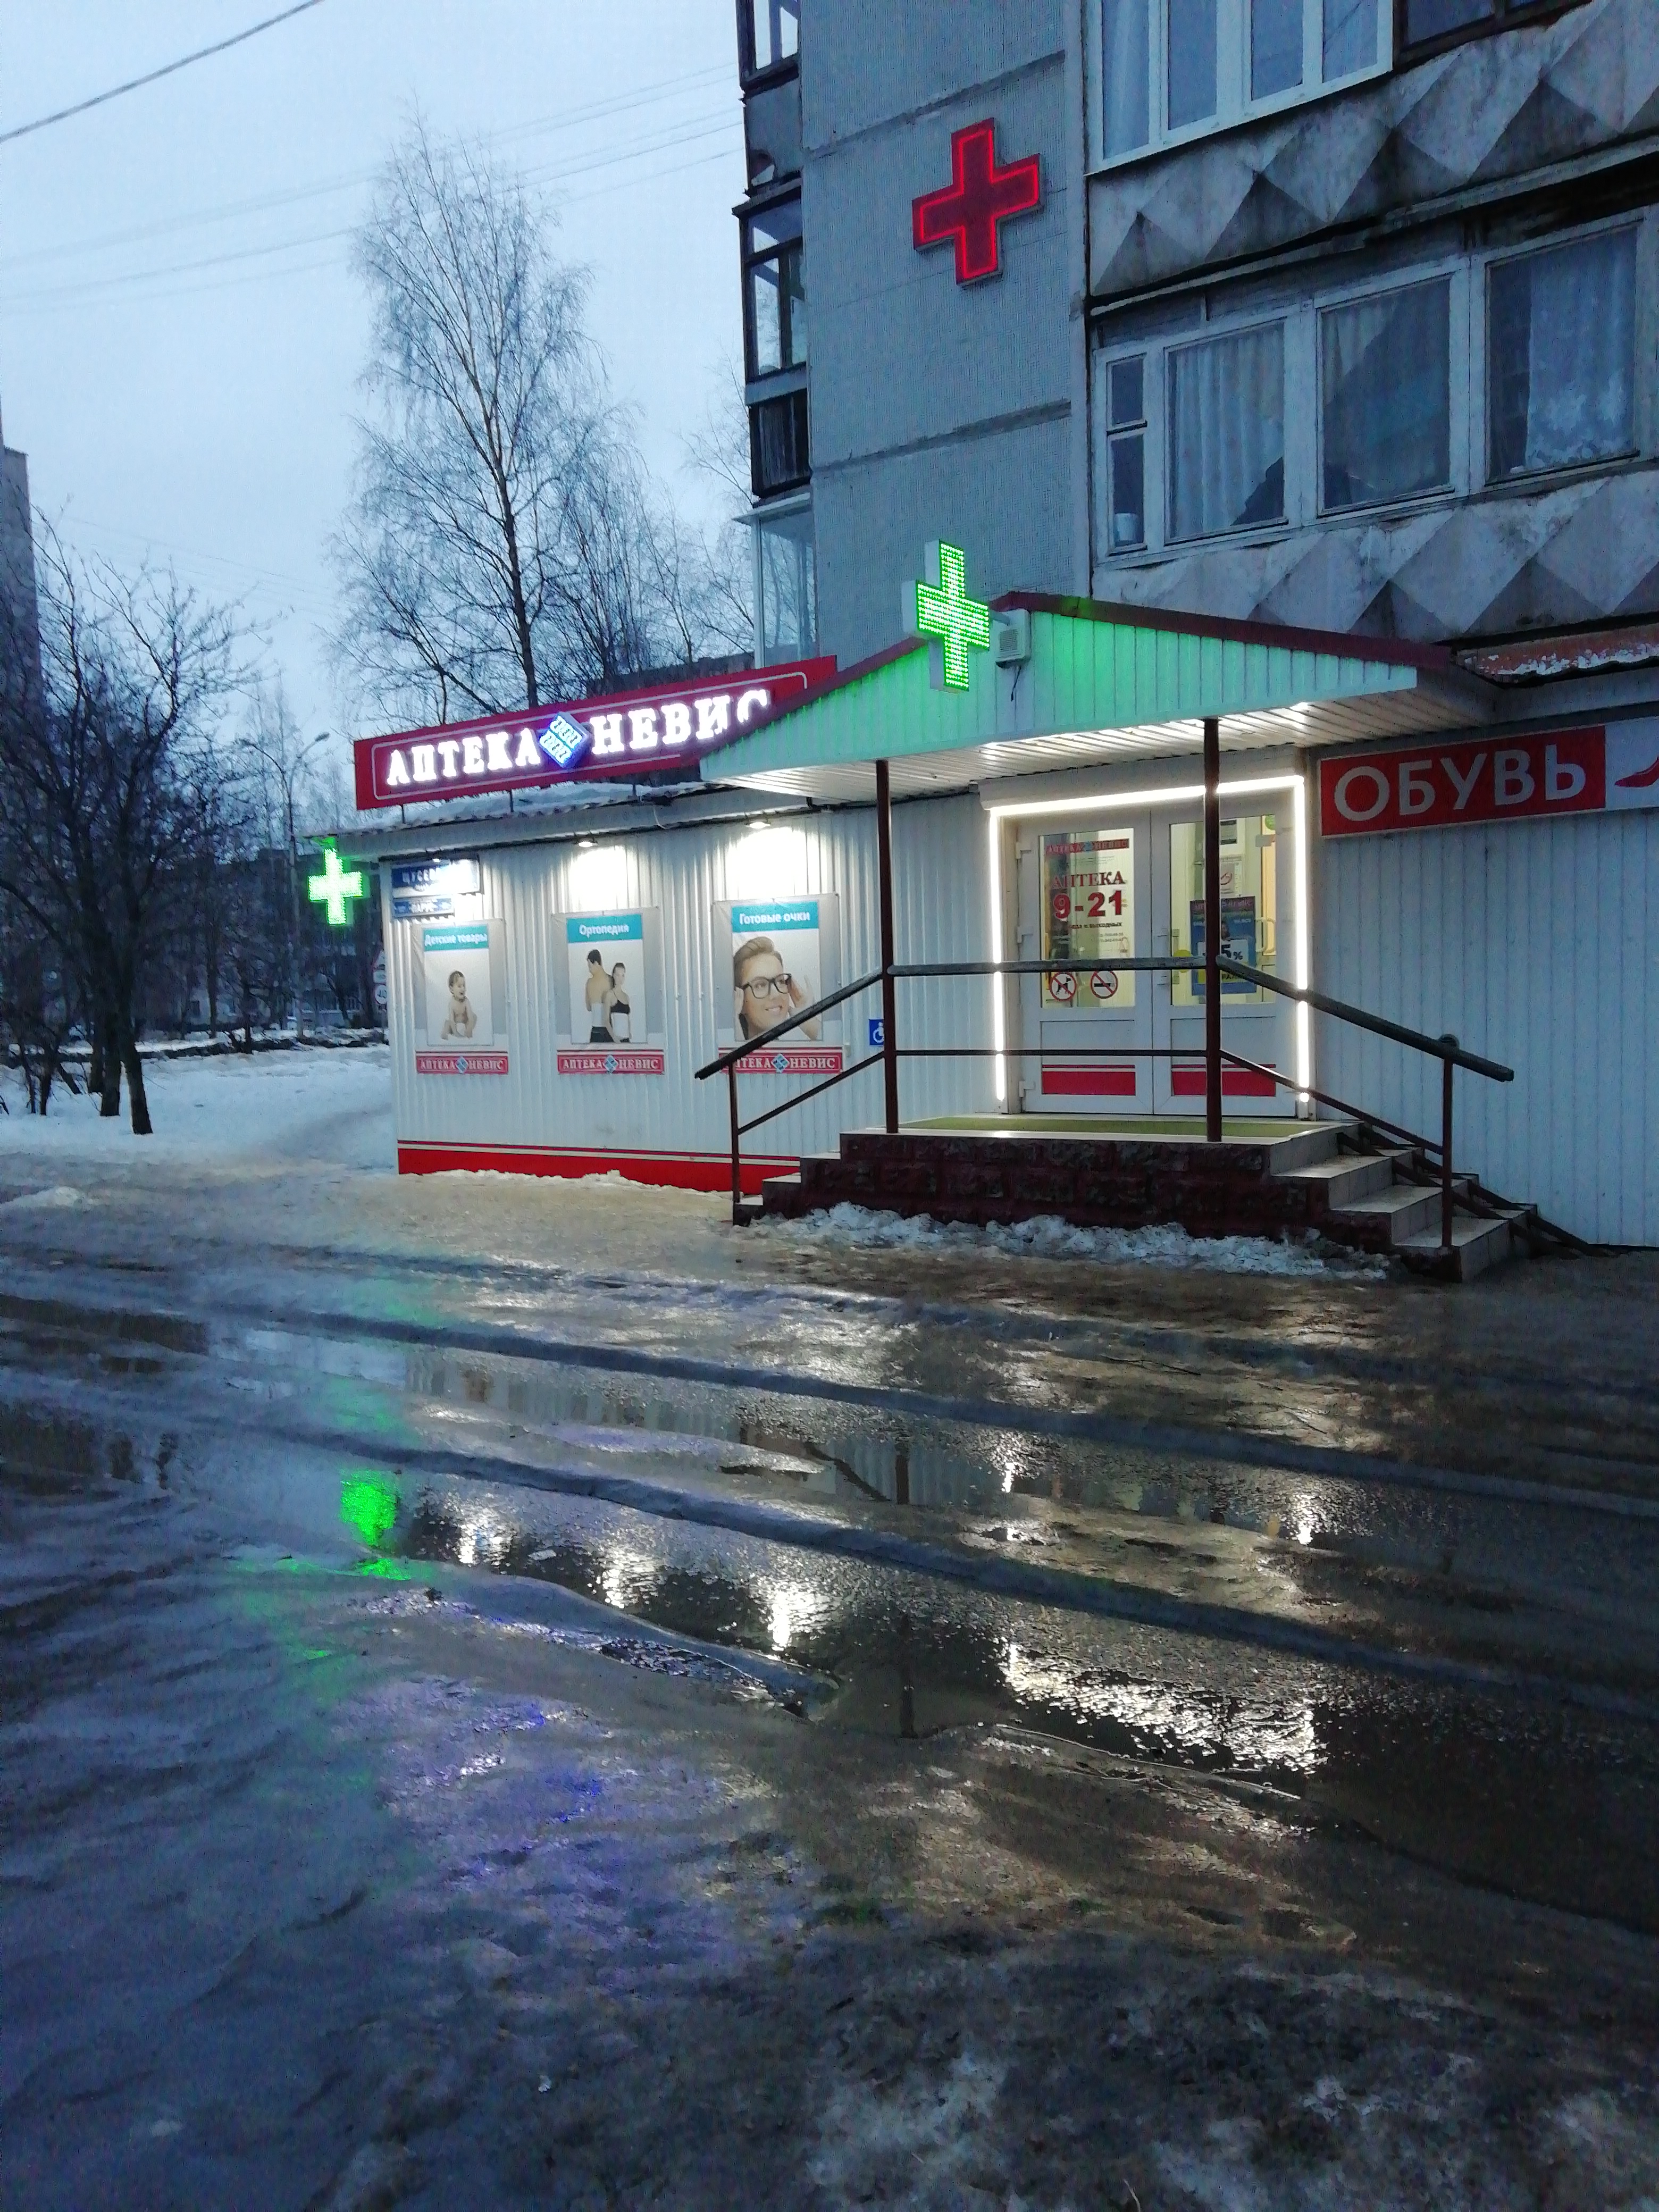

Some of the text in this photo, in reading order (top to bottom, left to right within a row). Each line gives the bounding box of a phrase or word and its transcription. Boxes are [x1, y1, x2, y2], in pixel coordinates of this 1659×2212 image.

[387, 727, 541, 786] АПТЕКА
[1334, 744, 1586, 822] ОБУВЬ
[1051, 870, 1125, 890] АПТЕКА
[739, 912, 810, 925] Готовые очки
[579, 924, 630, 939] Ортопедия
[425, 933, 488, 946] Детские товары
[420, 1059, 504, 1070] АПТЕКА НЕВИС
[563, 1059, 658, 1069] АПТЕКА НЕВИС
[735, 1057, 835, 1069] ТЕКА НЕВИС
